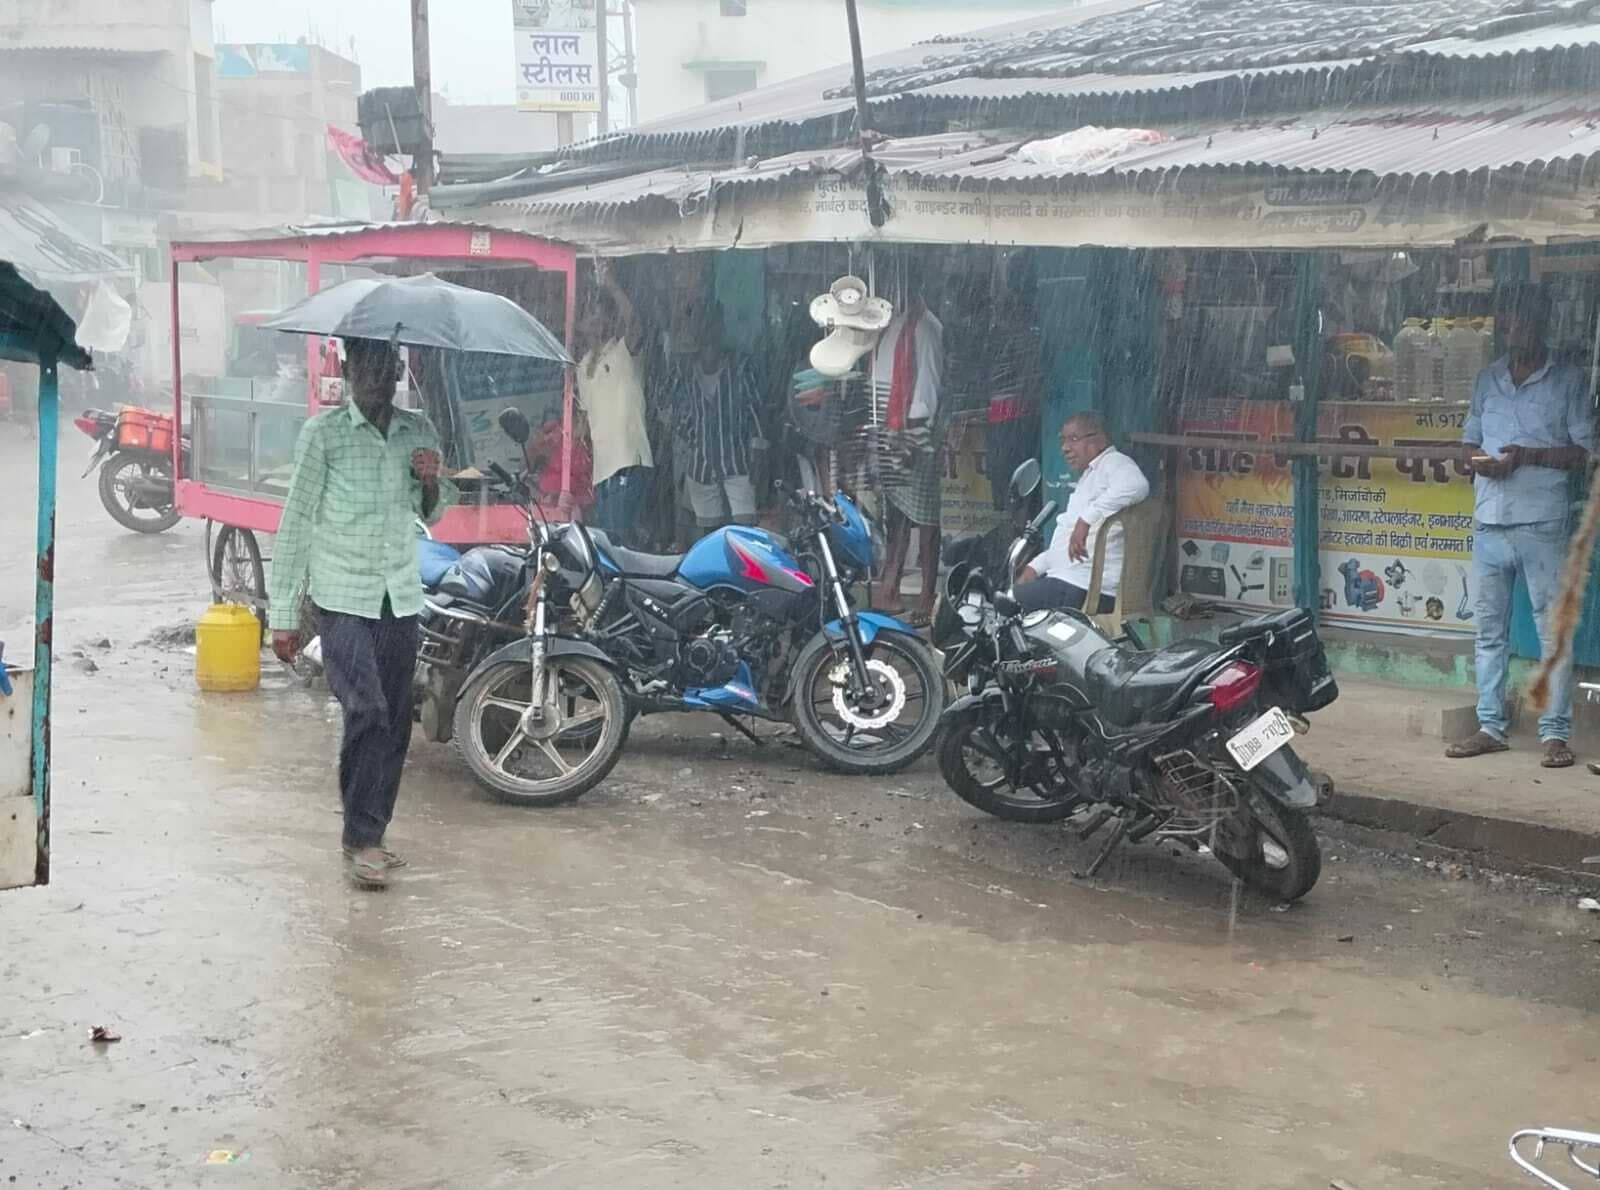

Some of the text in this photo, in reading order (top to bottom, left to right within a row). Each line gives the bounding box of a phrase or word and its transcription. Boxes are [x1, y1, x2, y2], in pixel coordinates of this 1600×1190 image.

[529, 34, 580, 55] लाल
[520, 56, 593, 84] स्टीलस
[1416, 408, 1465, 428] मो.912
